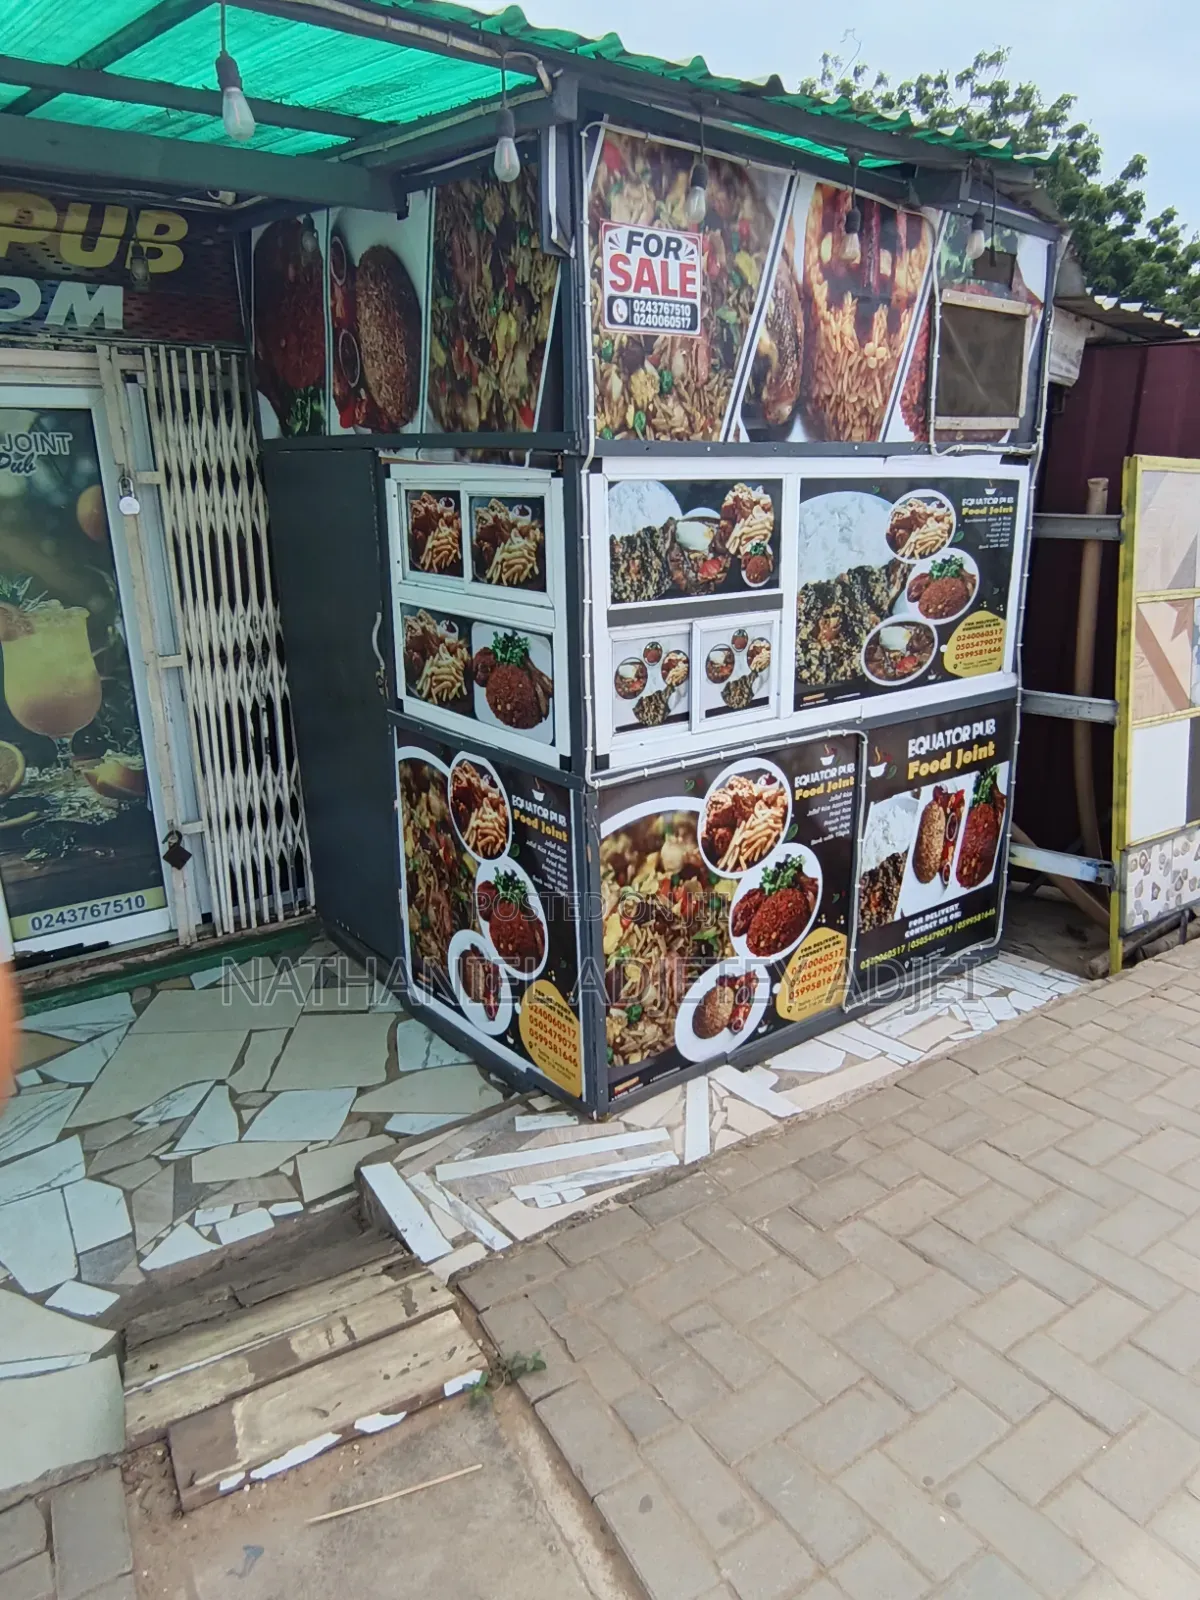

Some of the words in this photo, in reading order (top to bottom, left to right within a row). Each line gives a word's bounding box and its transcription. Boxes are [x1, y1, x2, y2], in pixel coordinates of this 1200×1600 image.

[0, 192, 188, 274] PUB
[625, 230, 683, 261] FOR
[609, 253, 697, 299] SALE
[633, 299, 691, 317] 0243767510
[633, 313, 691, 329] 0240060517
[2, 432, 73, 456] JOINT
[962, 507, 987, 516] Food
[989, 506, 1014, 515] Joint
[907, 725, 971, 759] EQUATOR
[972, 718, 996, 740] PUB
[794, 768, 837, 788] EQUATOR
[838, 762, 855, 777] PUB
[907, 750, 952, 780] Food
[955, 741, 995, 770] Joint
[795, 783, 824, 801] Food
[827, 776, 855, 793] Joint
[512, 795, 548, 819] EQUATOR
[550, 810, 566, 827] PUB
[513, 809, 539, 830] Food
[541, 821, 568, 842] Joint
[31, 894, 146, 931] 0243767510
[904, 920, 938, 939] CONTACT
[939, 916, 948, 925] US
[908, 917, 923, 928] FOR
[925, 903, 960, 922] DELIVERY
[801, 945, 812, 953] FOR
[814, 934, 839, 949] DELIVERY
[528, 1002, 577, 1038] 0240060517
[528, 1015, 578, 1052] 0505479079
[528, 1028, 578, 1068] 0599581646
